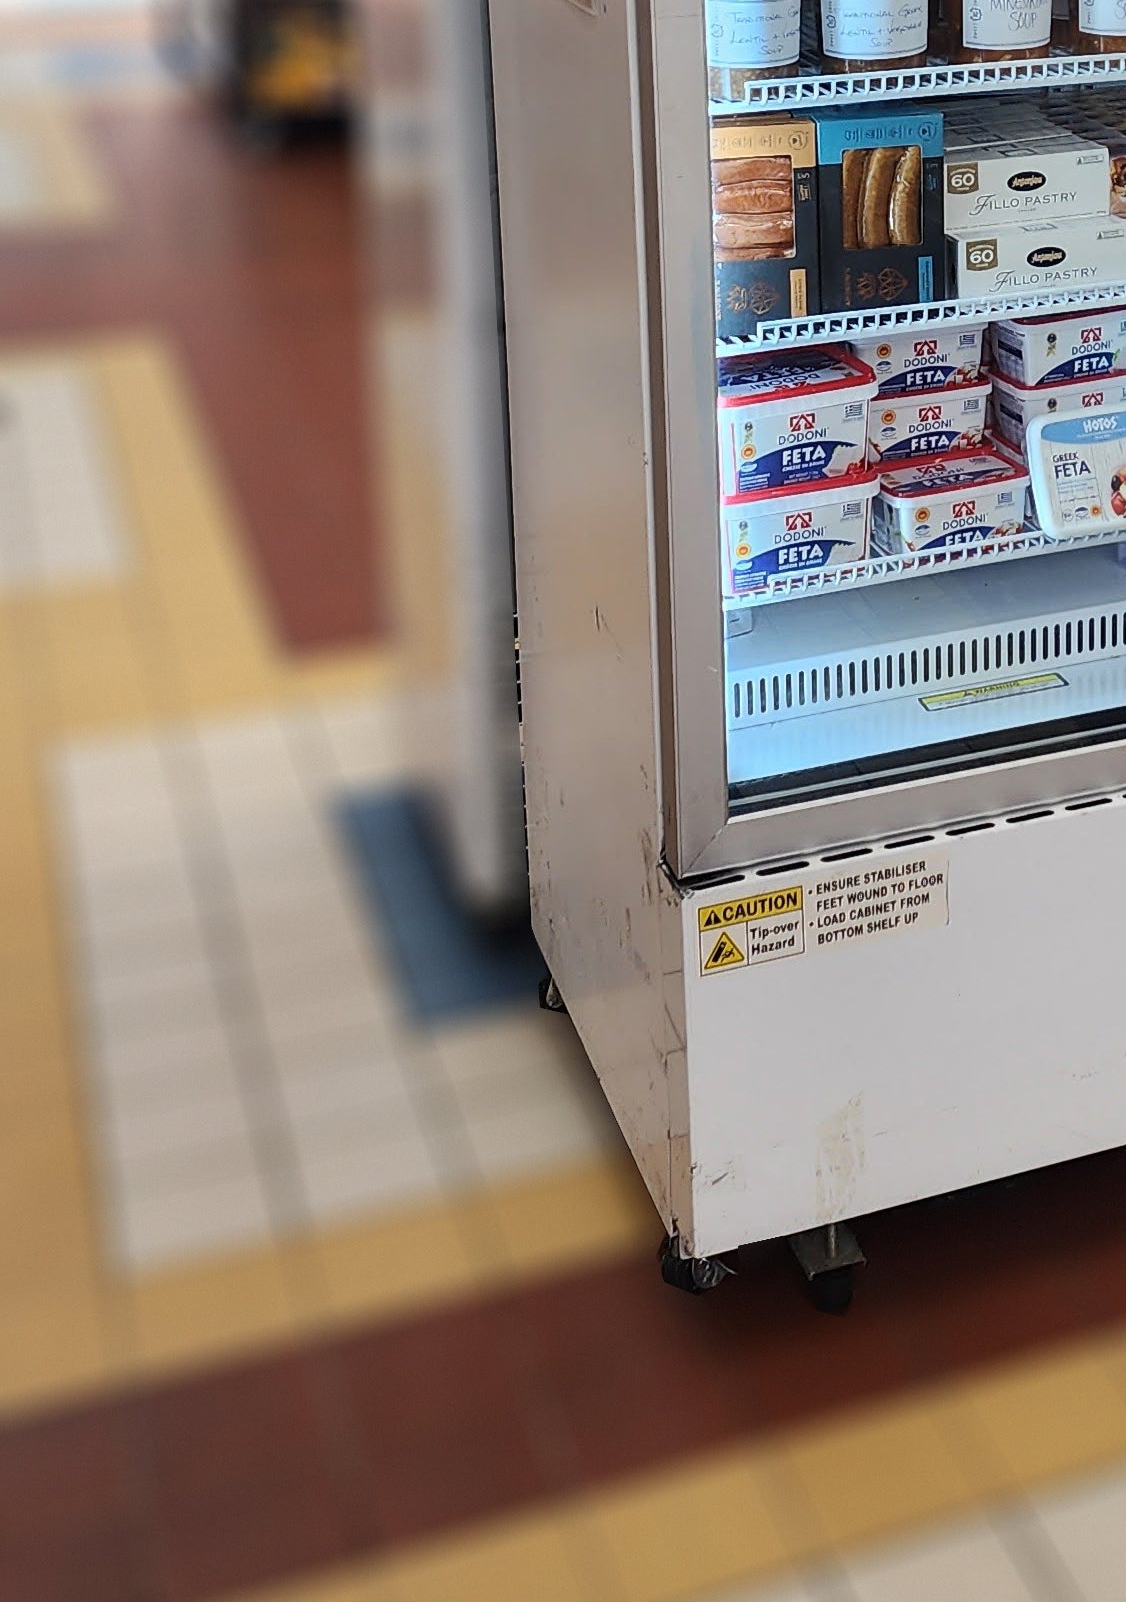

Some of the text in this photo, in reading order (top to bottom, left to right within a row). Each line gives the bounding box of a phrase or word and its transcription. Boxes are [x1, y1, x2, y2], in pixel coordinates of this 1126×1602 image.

[1007, 11, 1038, 32] SOUP
[951, 173, 976, 188] 60
[968, 191, 1078, 216] FILLO PASTRY
[969, 249, 995, 264] 60
[988, 266, 1098, 293] FILLO PASTRY
[1071, 341, 1111, 356] DODONI
[904, 353, 948, 368] DODONI
[1073, 355, 1110, 373] FETA
[906, 369, 946, 386] FETA
[908, 418, 952, 434] DODONI
[778, 429, 828, 446] DODONI
[911, 434, 950, 452] FETA
[782, 444, 827, 466] FETA
[1052, 451, 1080, 464] GREEK
[1053, 461, 1092, 480] FETA
[942, 516, 987, 532] DODONI
[774, 526, 824, 545] DODONI
[945, 531, 984, 547] FETA
[778, 543, 824, 565] FETA
[816, 860, 927, 896] ENSURE STABILISER
[816, 872, 944, 912] FEET WOUND TO FLOOR
[722, 891, 798, 923] CAUTION
[817, 891, 930, 929] LOAD CABINET FROM
[750, 920, 800, 942] Tip-over
[817, 911, 919, 946] BOTTOM SHELF UP
[751, 935, 796, 956] Hazard
